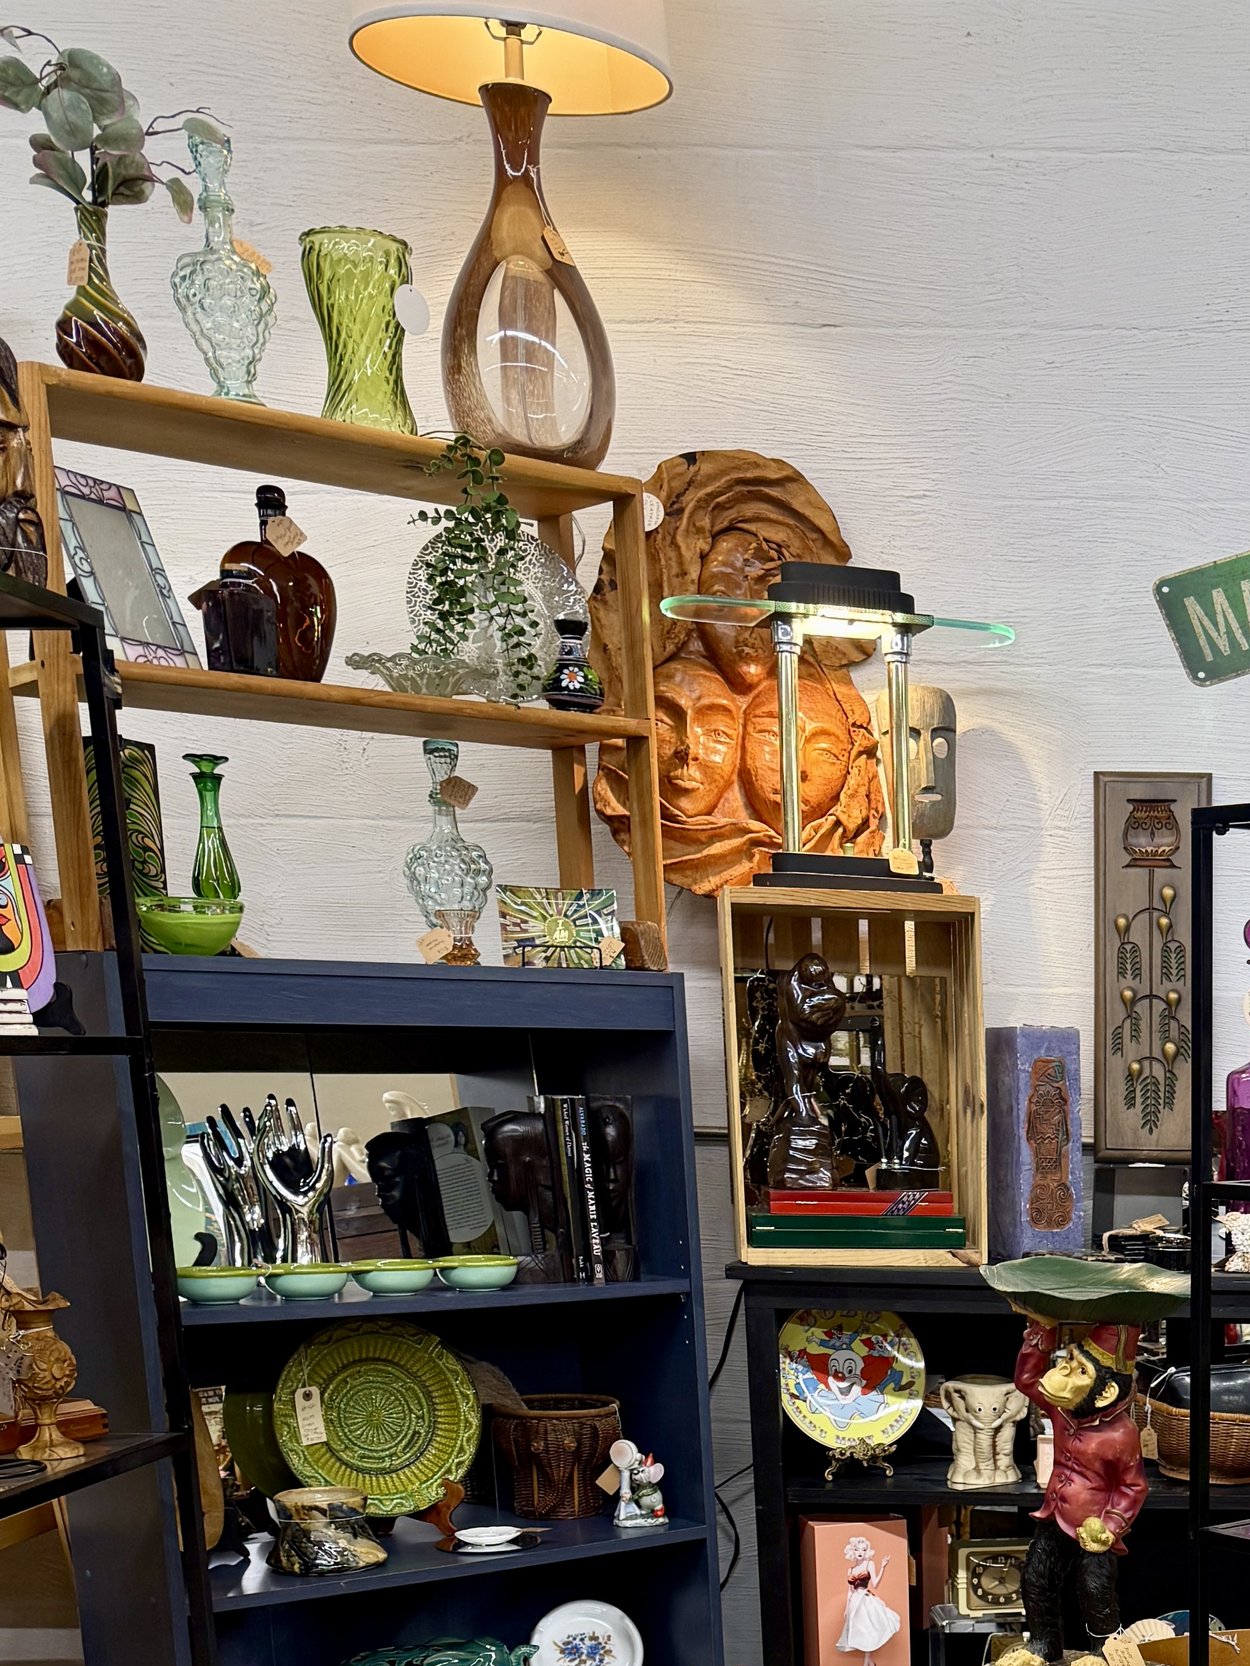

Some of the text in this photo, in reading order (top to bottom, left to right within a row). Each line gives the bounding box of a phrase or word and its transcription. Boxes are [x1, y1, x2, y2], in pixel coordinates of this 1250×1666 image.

[577, 1106, 586, 1136] ALVARADO
[582, 1151, 592, 1182] MAGIC
[586, 1189, 597, 1219] MARIE
[589, 1221, 601, 1256] LAVEAU
